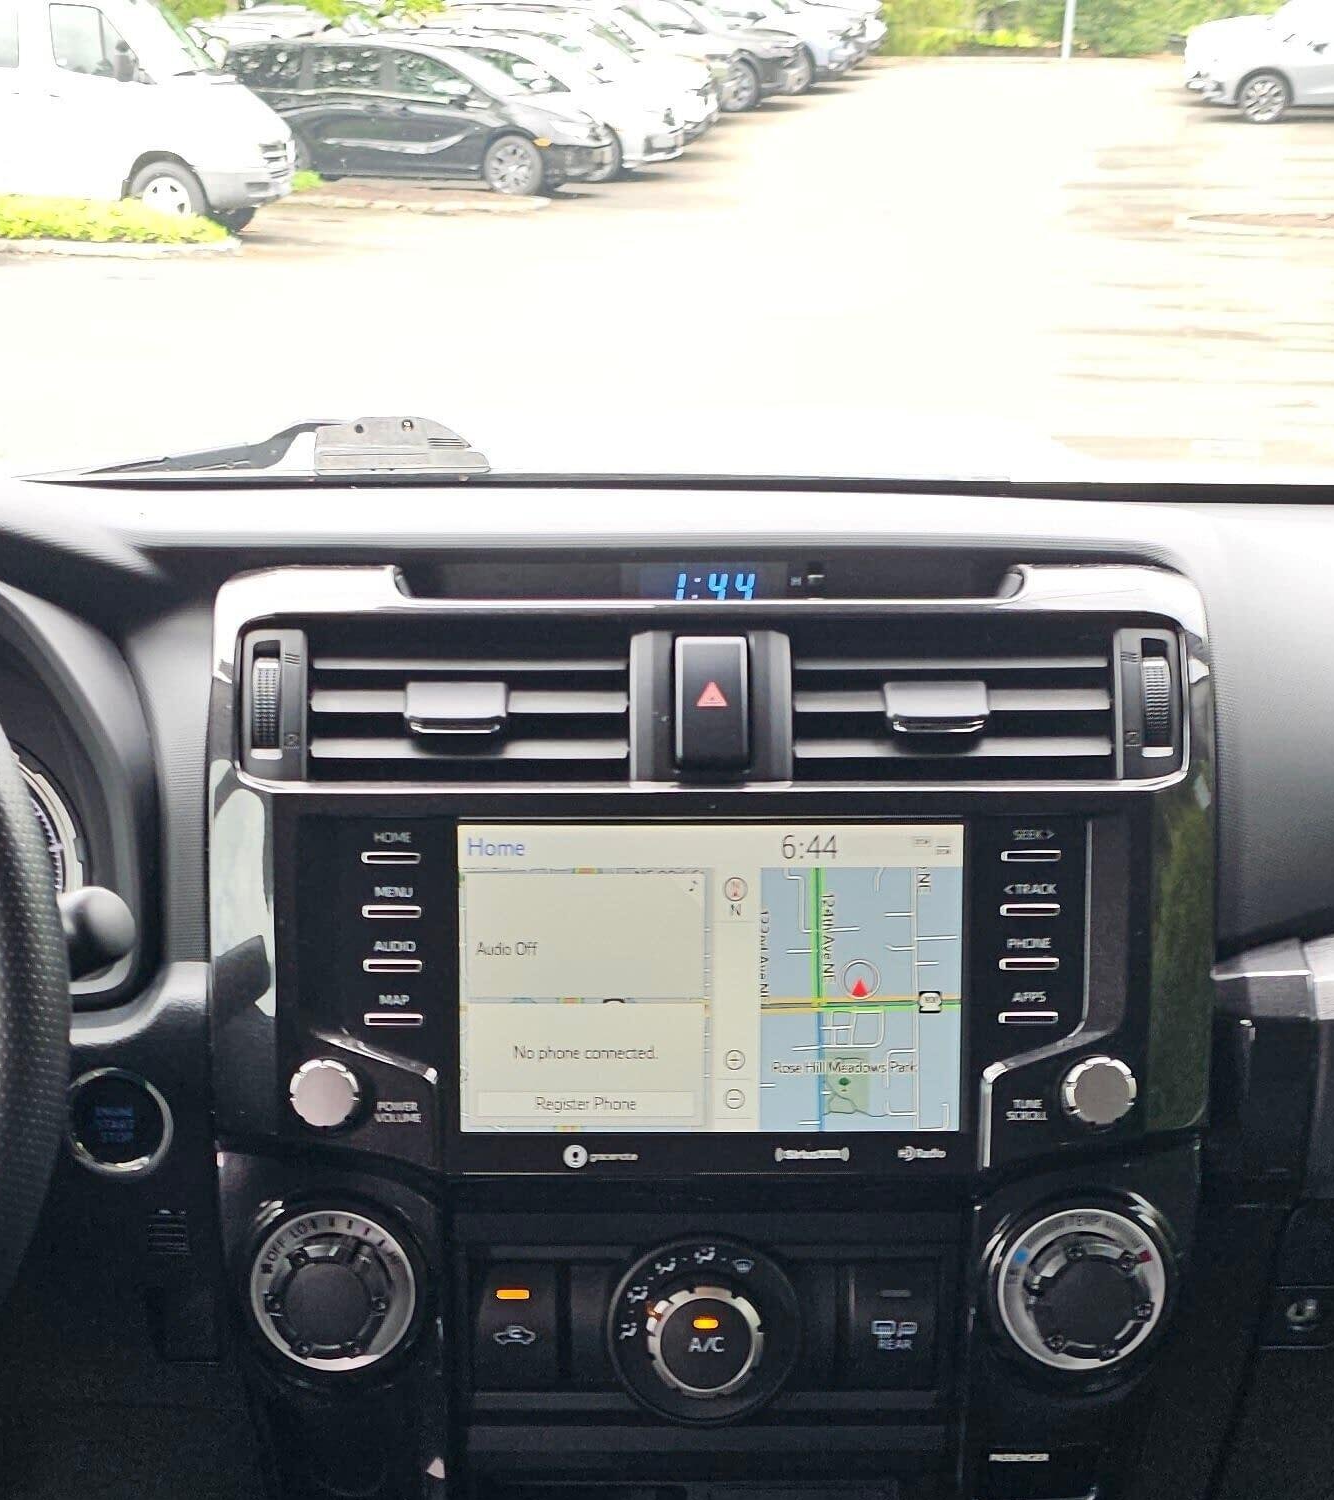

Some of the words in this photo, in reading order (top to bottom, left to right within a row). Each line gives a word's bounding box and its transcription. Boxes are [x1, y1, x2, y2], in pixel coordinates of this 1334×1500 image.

[674, 573, 756, 601] 1:44
[373, 832, 412, 843] HOME
[467, 837, 526, 857] Home
[782, 834, 839, 859] 6:44
[374, 886, 414, 898] MENU
[1015, 884, 1057, 895] TRACK
[373, 940, 417, 953] AUDIO
[475, 941, 512, 956] Audio
[516, 941, 538, 956] Off
[822, 935, 836, 960] Ave
[1007, 938, 1052, 949] PHONE
[378, 994, 410, 1005] MAP
[1012, 991, 1047, 1002] APPS
[514, 1046, 536, 1060] No
[538, 1046, 581, 1062] phone
[584, 1046, 659, 1060] connected.
[773, 1061, 802, 1074] Rose
[805, 1061, 825, 1074] Hill
[828, 1061, 887, 1074] Meadows
[889, 1061, 919, 1074] Park
[376, 1101, 418, 1111] POWER
[535, 1096, 590, 1113] Register
[594, 1096, 637, 1111] Phone
[1013, 1099, 1043, 1109] TUNE
[373, 1112, 421, 1123] VOLUME
[1005, 1111, 1048, 1121] SCROLL
[688, 1337, 725, 1353] A/C
[877, 1339, 914, 1351] REAR
